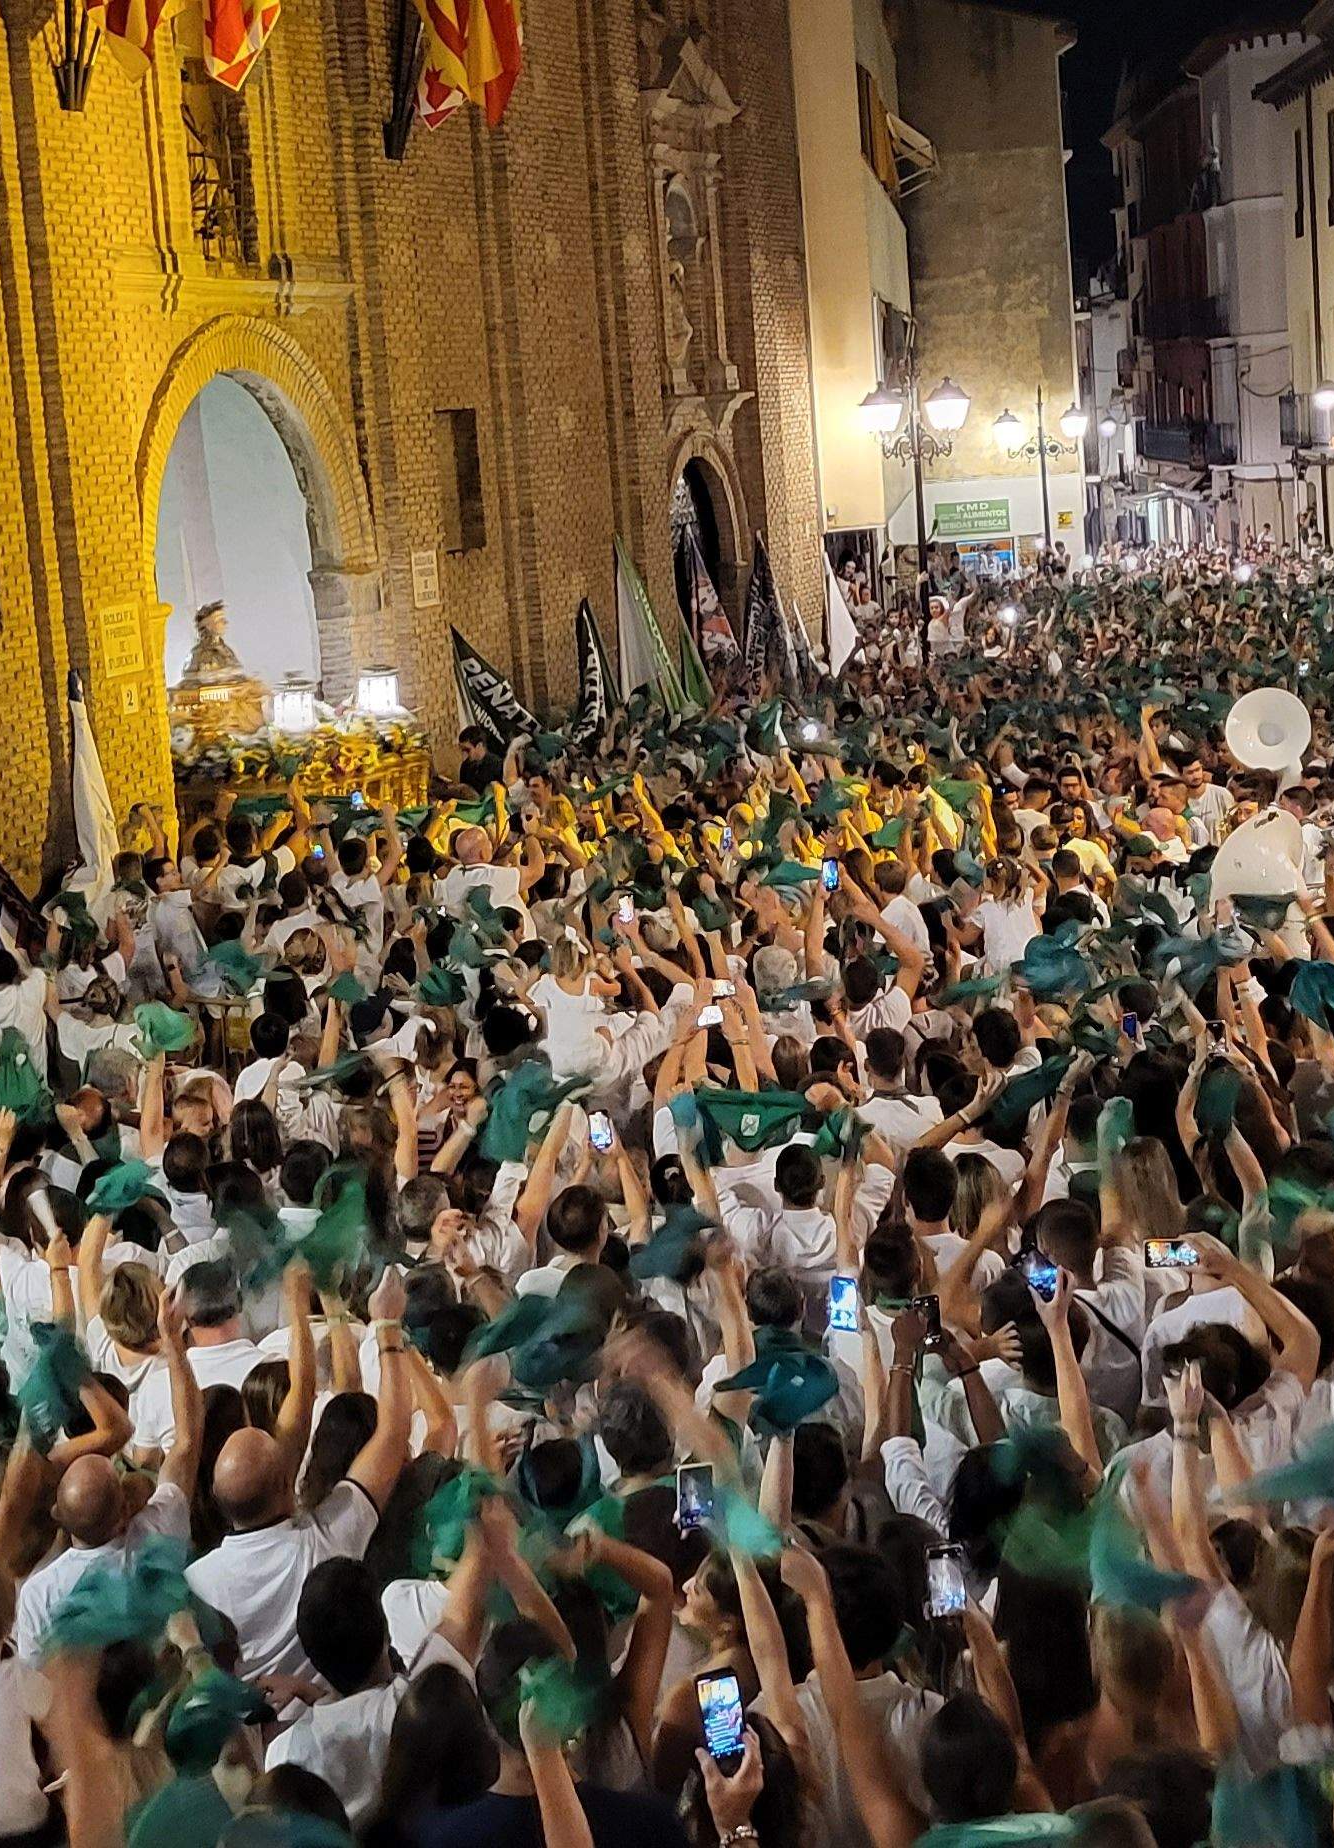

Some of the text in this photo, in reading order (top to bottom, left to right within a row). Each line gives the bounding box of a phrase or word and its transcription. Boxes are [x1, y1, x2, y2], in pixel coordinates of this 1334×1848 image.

[956, 503, 988, 513] KMD
[962, 509, 1007, 519] ALIMENTOS
[460, 657, 521, 720] PEÑA
[126, 689, 134, 707] 2
